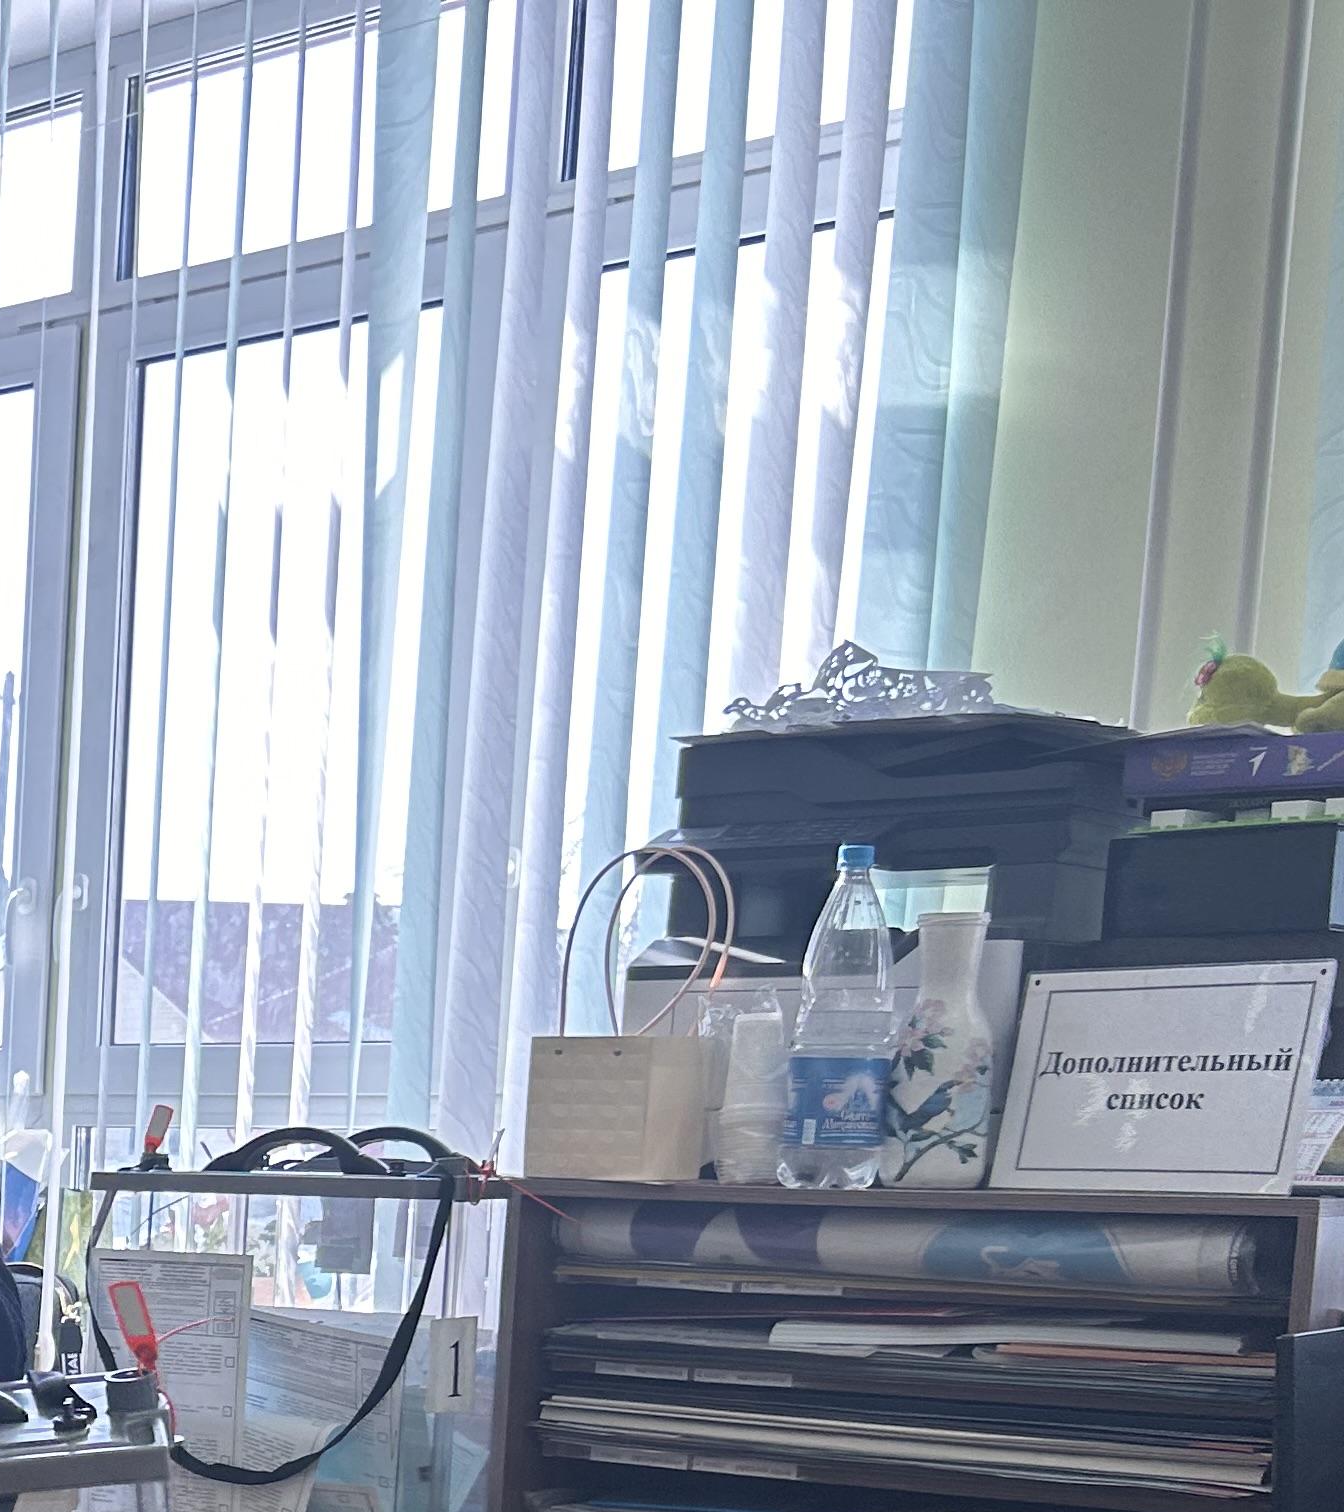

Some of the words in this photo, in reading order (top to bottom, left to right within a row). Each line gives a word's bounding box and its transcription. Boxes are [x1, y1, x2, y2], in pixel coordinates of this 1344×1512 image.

[1039, 1047, 1294, 1077] Дополнительный
[1105, 1091, 1205, 1111] список
[448, 1340, 463, 1398] 1
